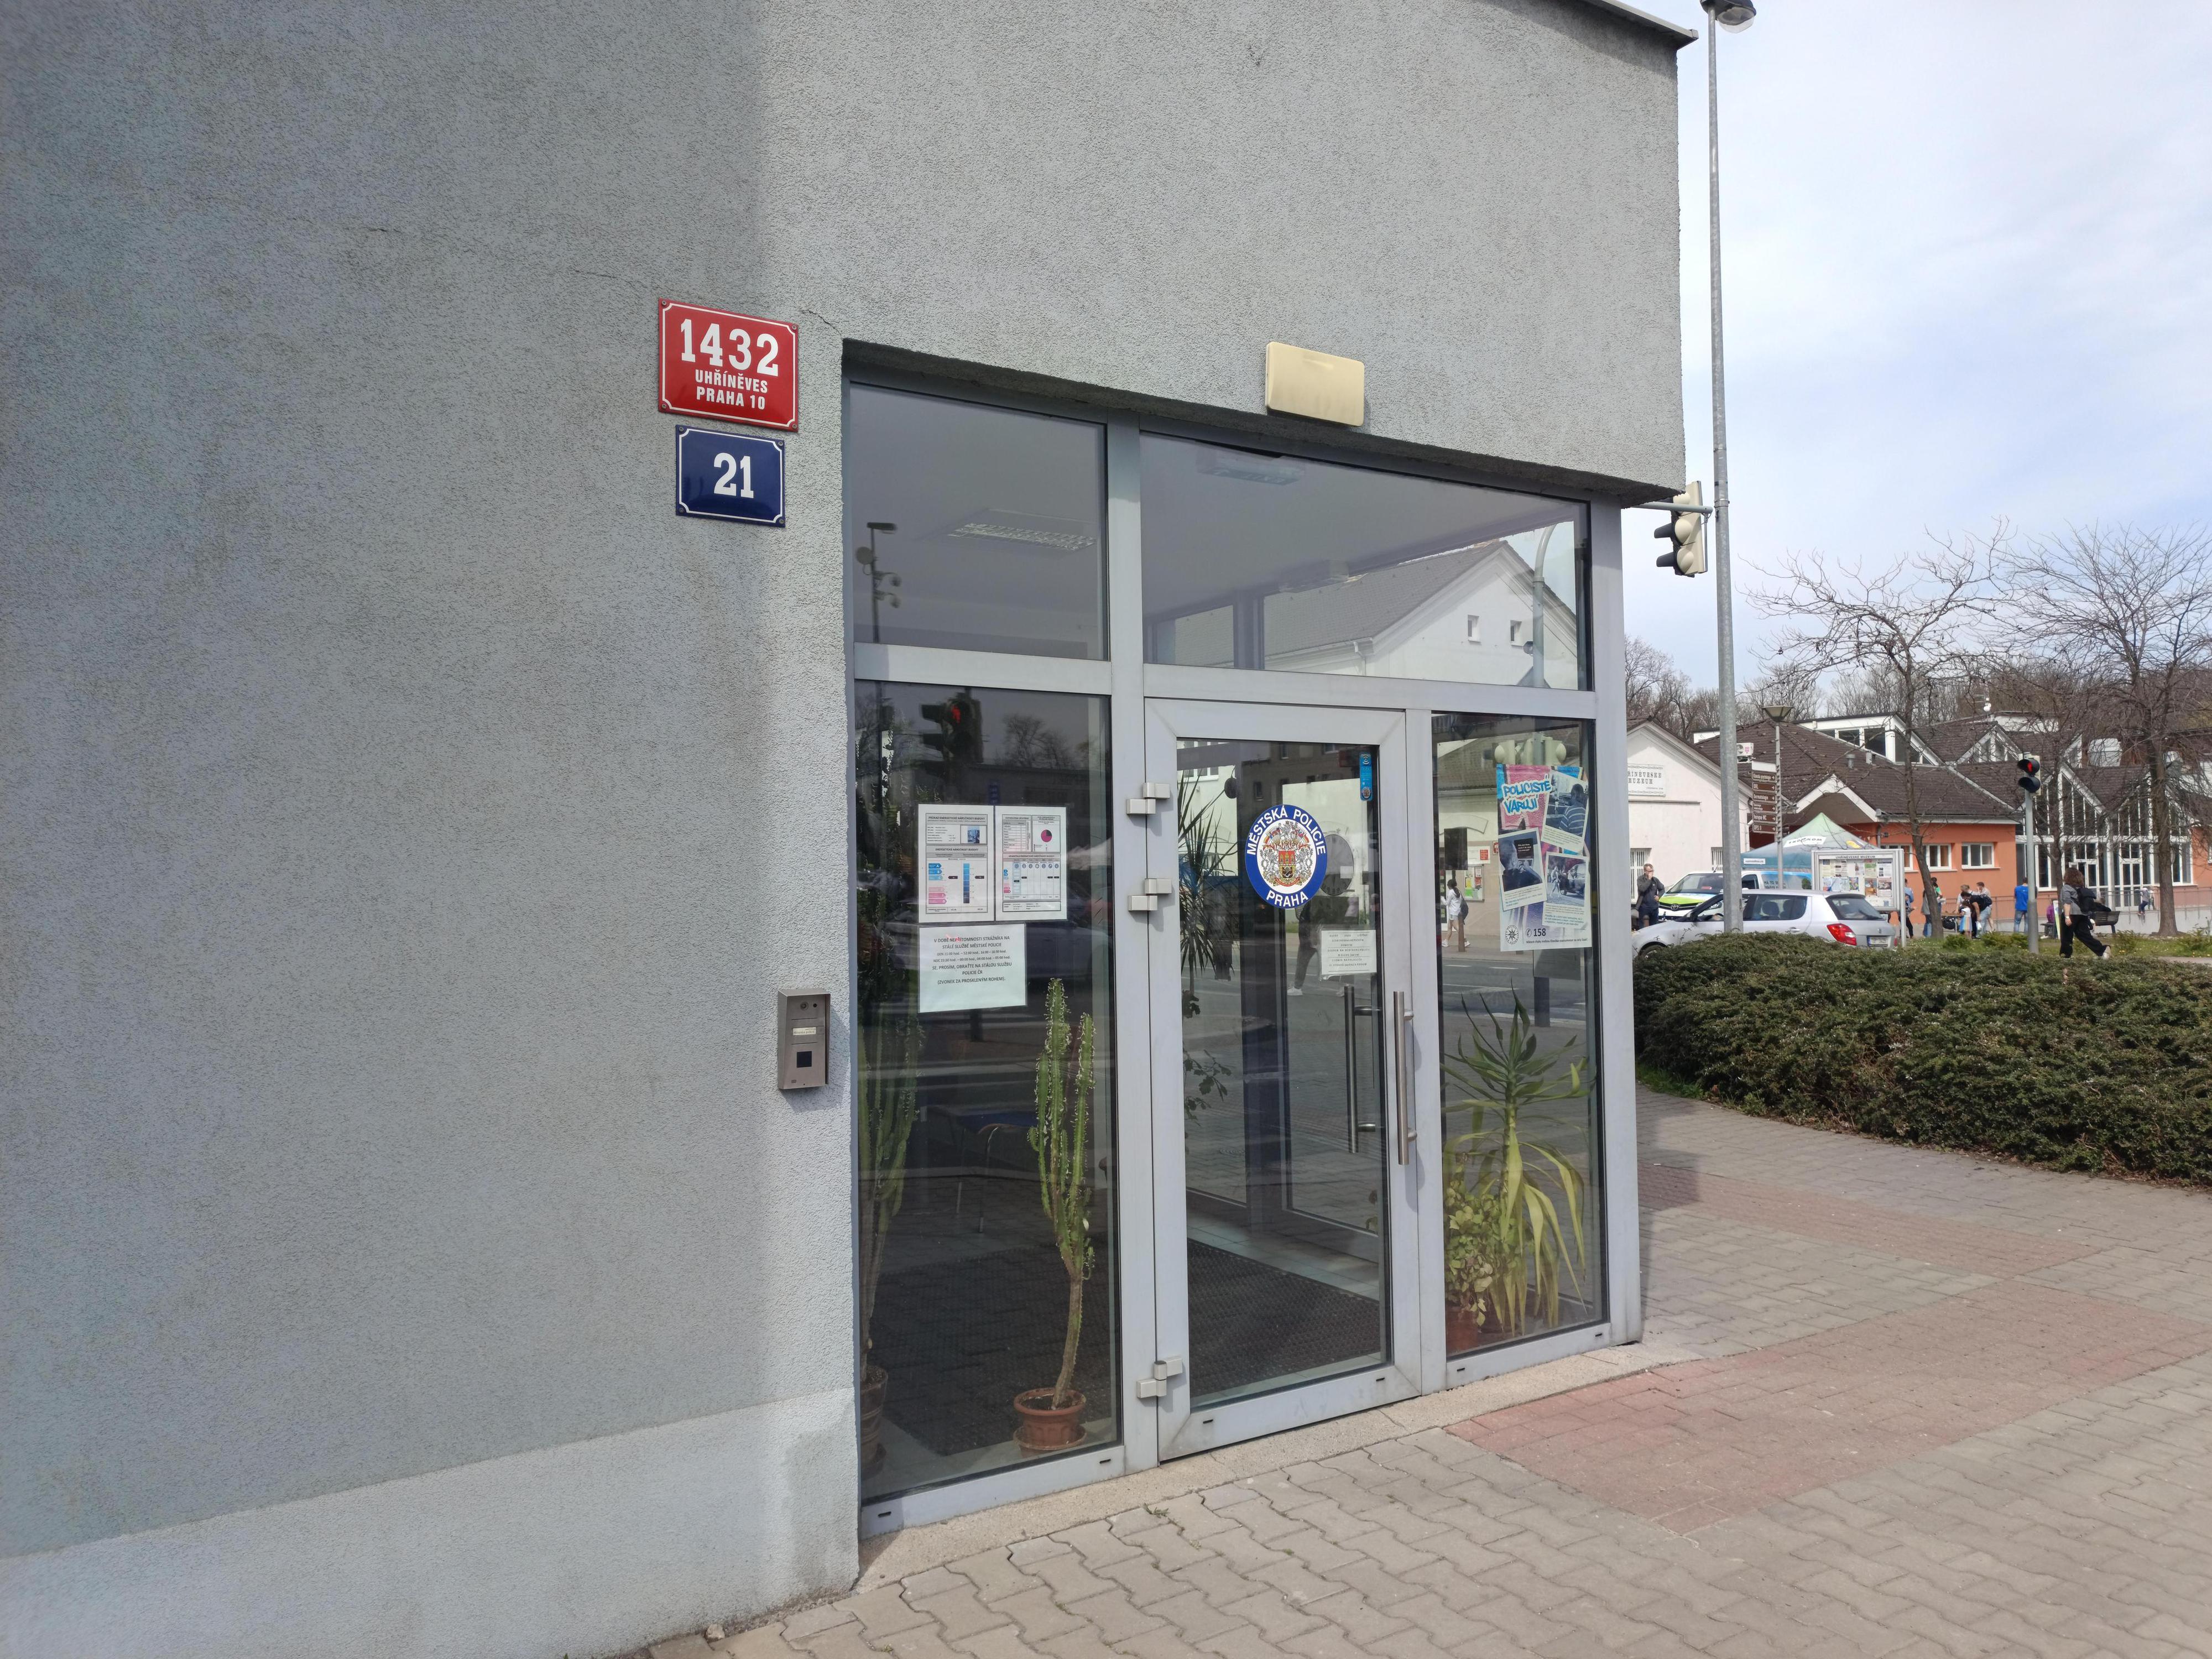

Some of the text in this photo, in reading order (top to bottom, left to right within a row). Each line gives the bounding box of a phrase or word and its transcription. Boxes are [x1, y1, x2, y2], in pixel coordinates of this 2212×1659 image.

[680, 319, 779, 377] 1432
[695, 369, 768, 393] UHŘÍNĚVES
[696, 388, 765, 410] PRAHA 10
[713, 452, 754, 498] 21
[1247, 805, 1326, 855] MĚSTSKÁ POLICIE
[1266, 891, 1309, 907] PRAHA
[1533, 928, 1546, 937] 158
